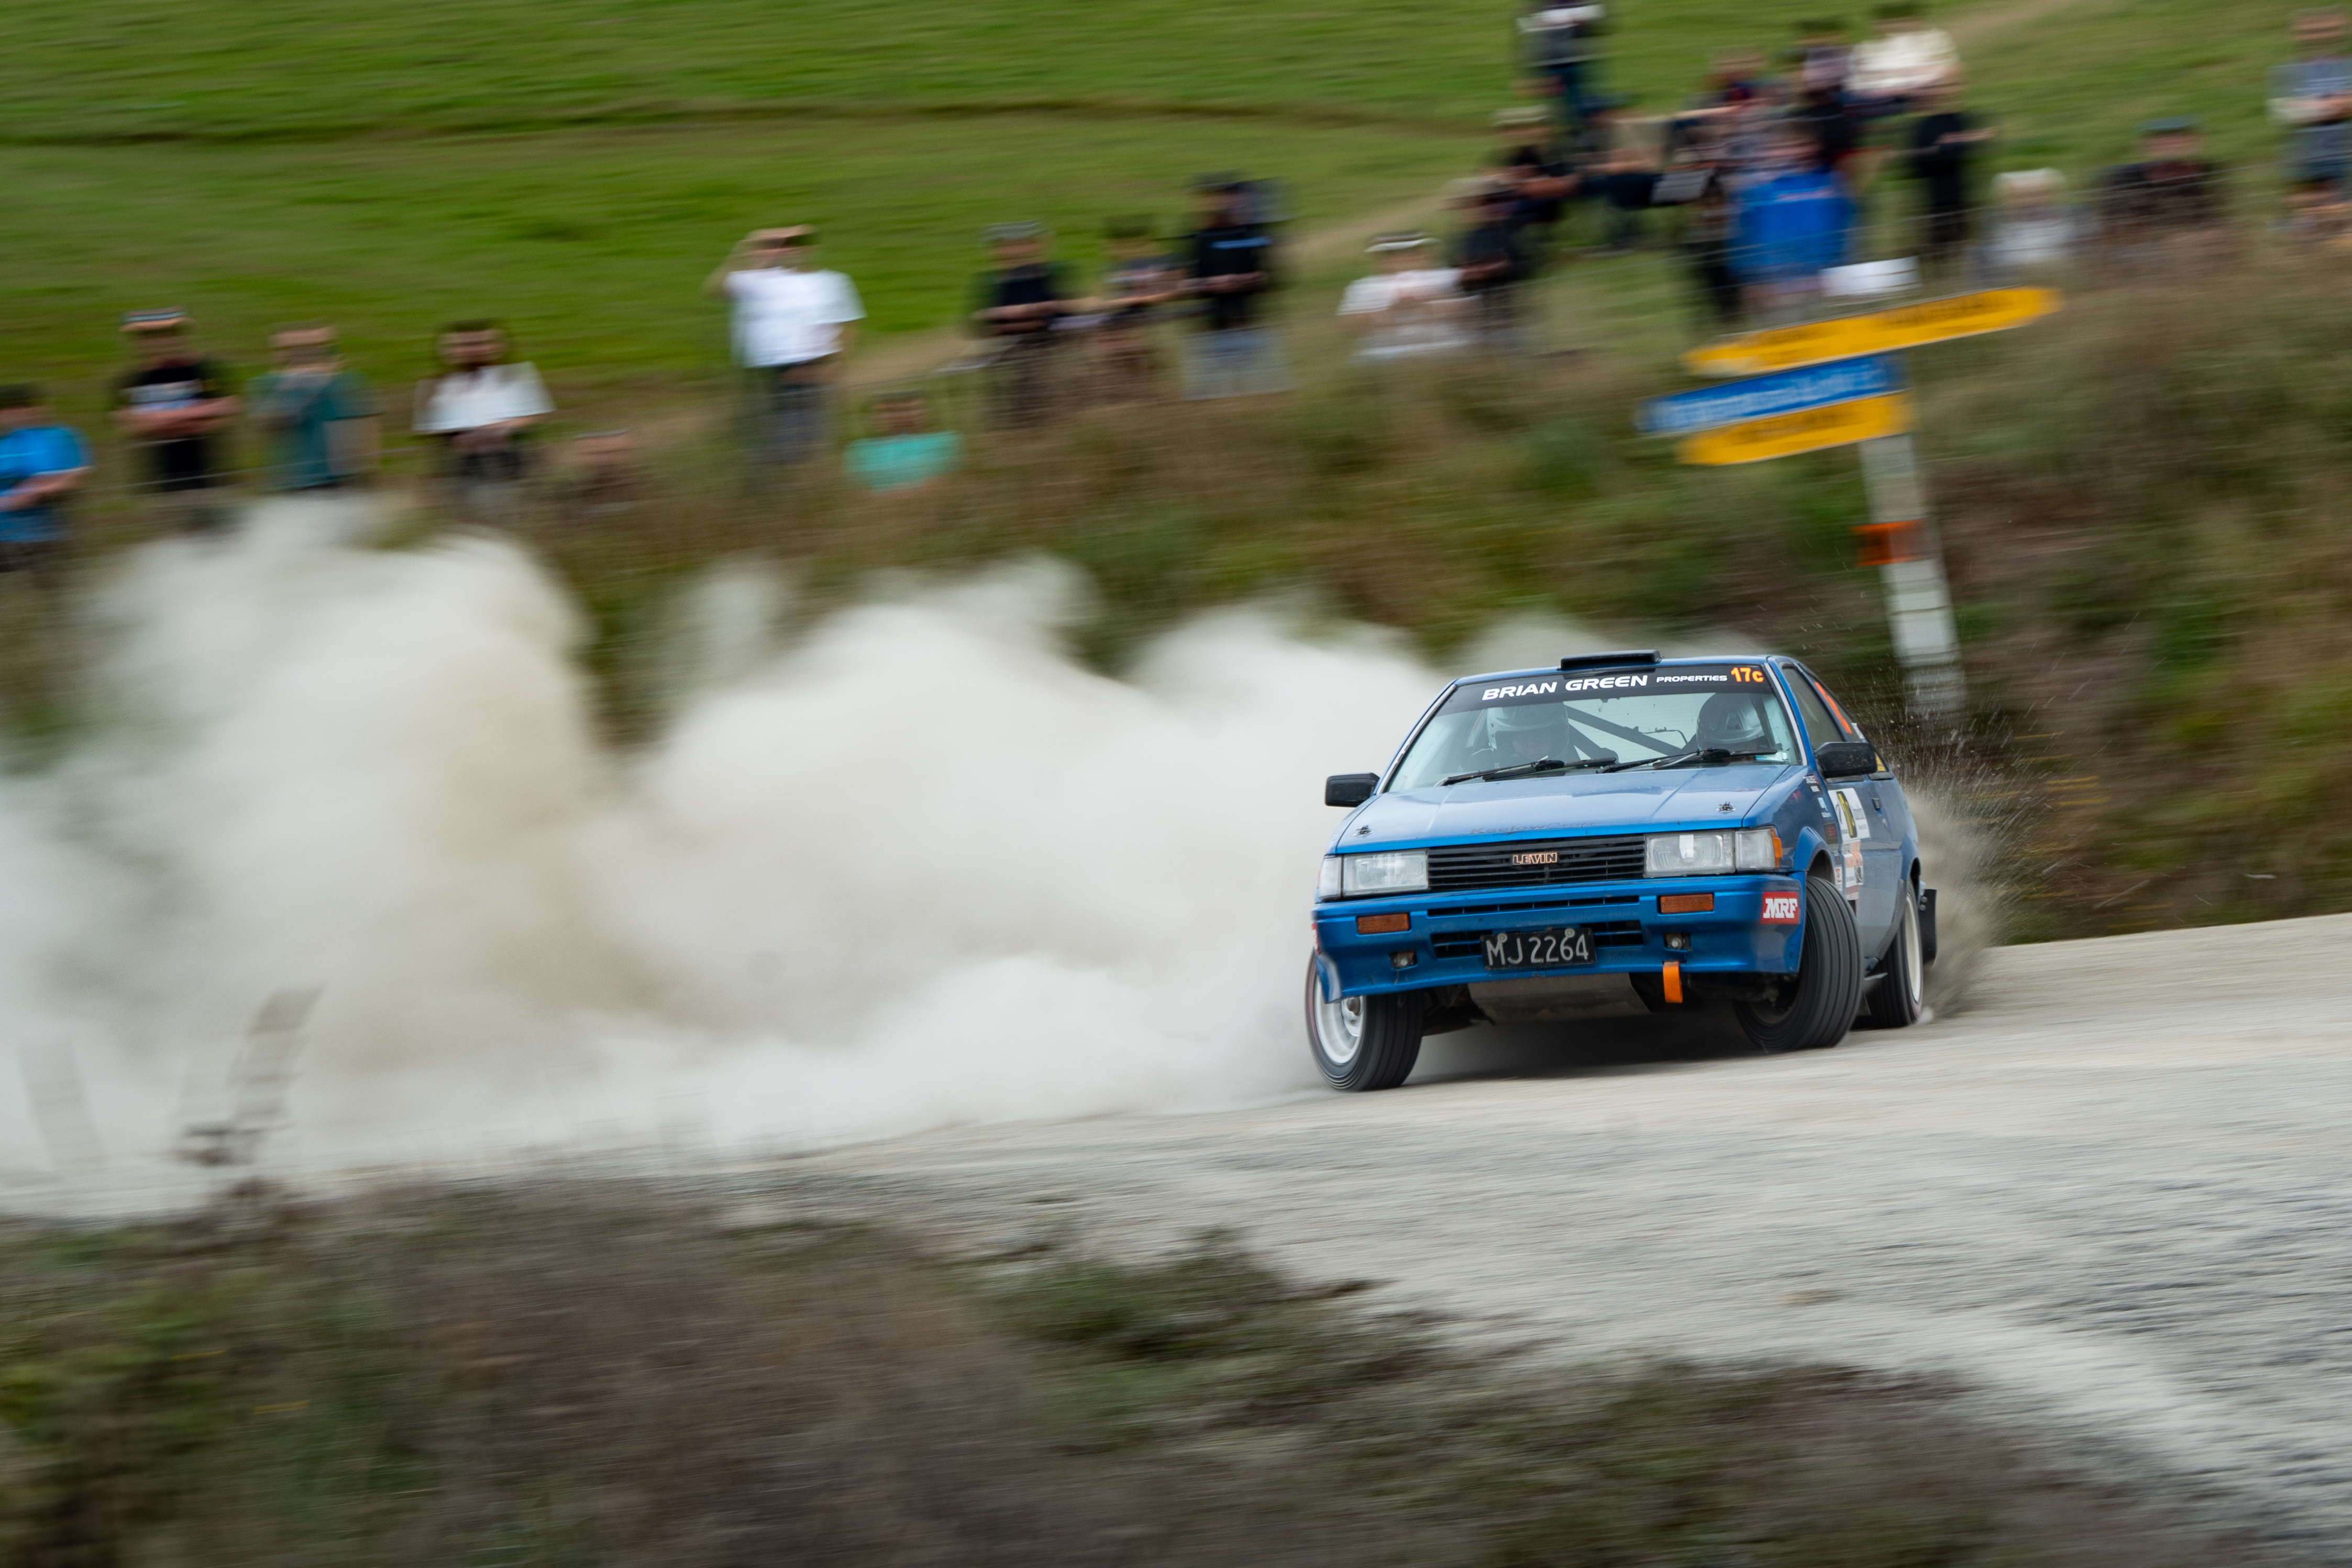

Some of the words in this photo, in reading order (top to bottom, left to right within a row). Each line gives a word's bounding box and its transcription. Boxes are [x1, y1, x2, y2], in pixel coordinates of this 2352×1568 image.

[1482, 681, 1558, 701] BRIAN
[1565, 675, 1648, 691] GREEN
[1512, 852, 1559, 865] LEVIN
[1763, 898, 1798, 919] MRF
